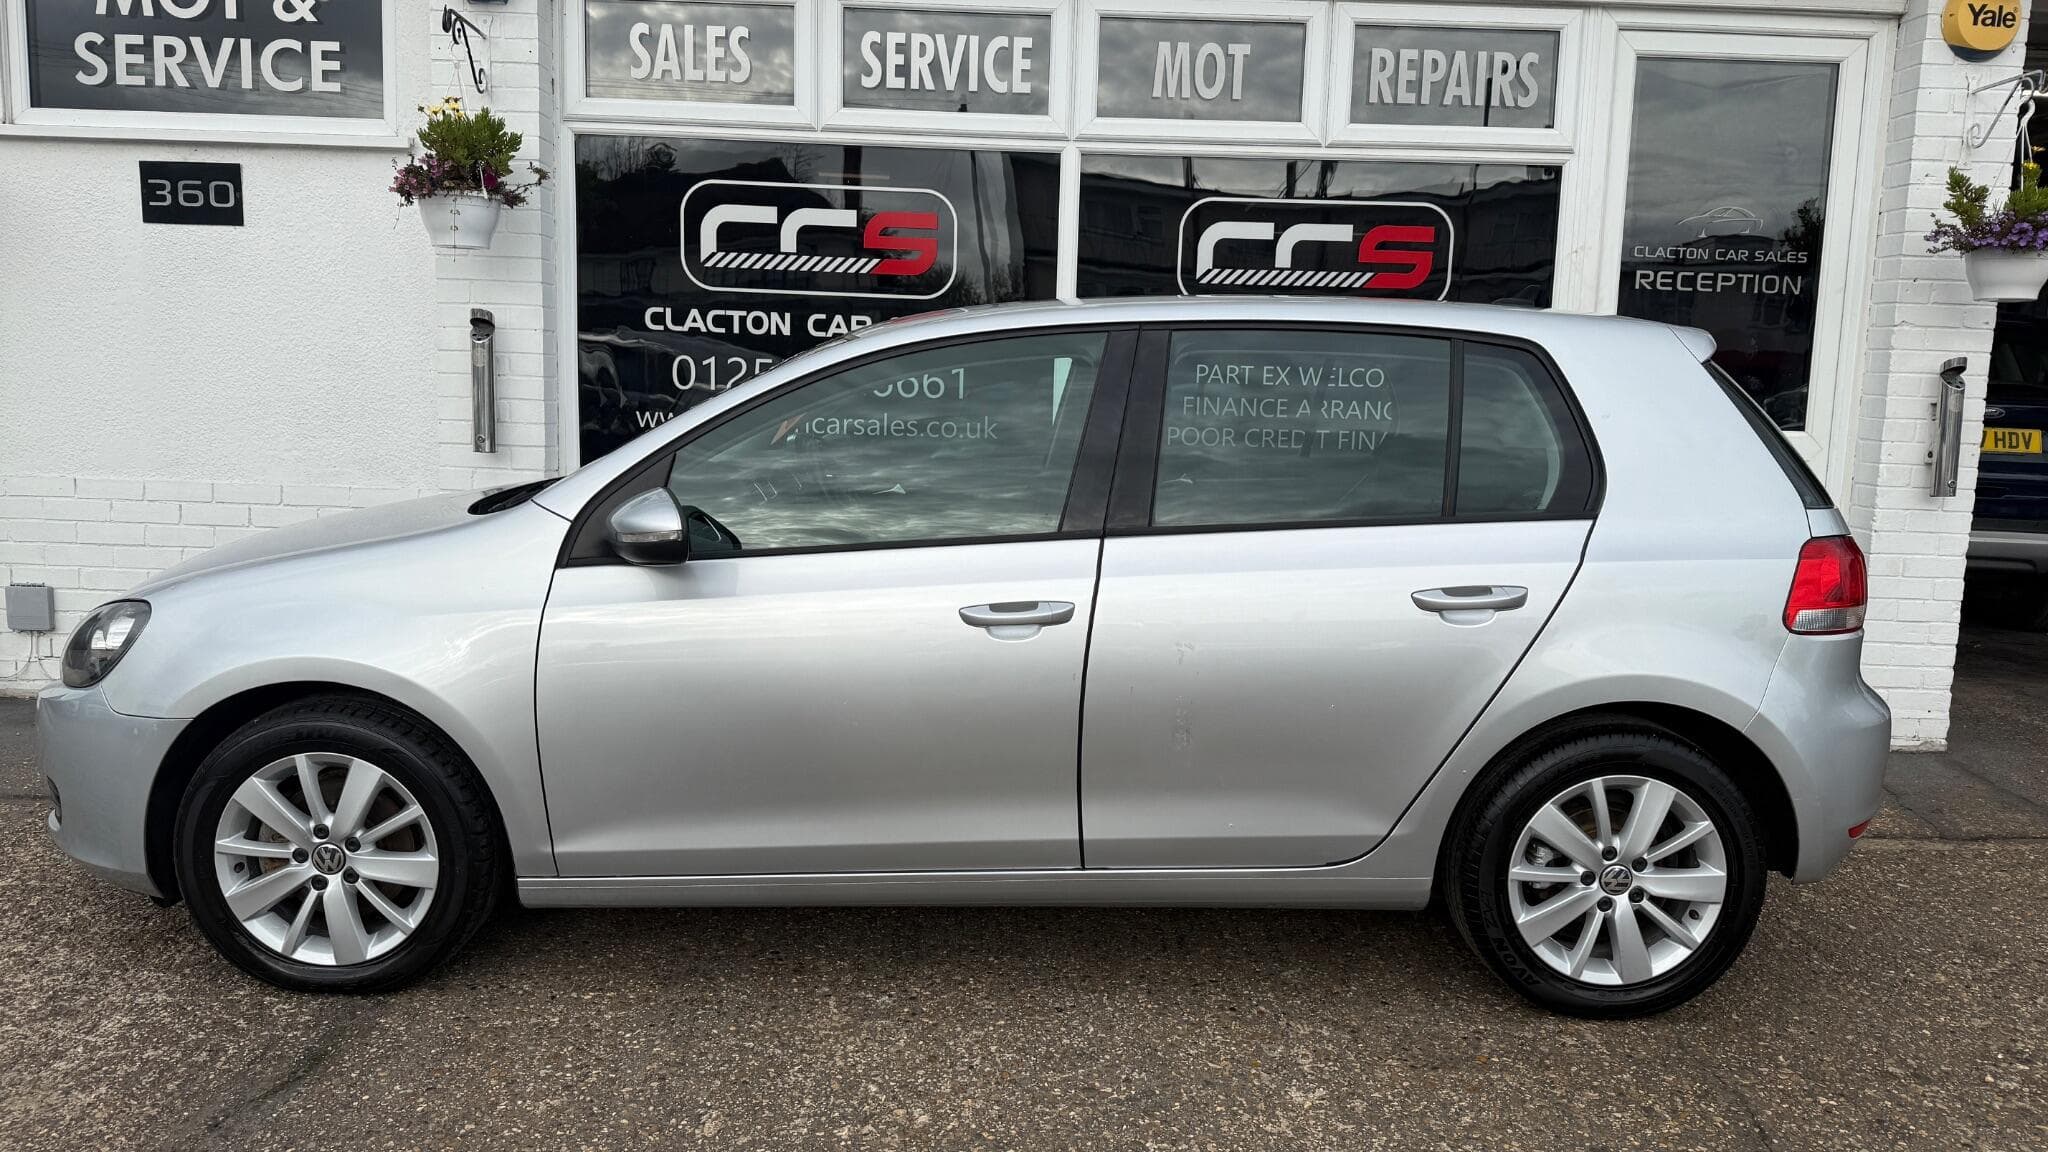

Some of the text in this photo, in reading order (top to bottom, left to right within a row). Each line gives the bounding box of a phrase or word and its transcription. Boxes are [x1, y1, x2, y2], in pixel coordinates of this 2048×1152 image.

[1968, 3, 2016, 28] Yale
[74, 32, 342, 92] SERVICE
[629, 22, 751, 84] SALES
[860, 30, 1033, 93] SERVICE
[1152, 41, 1251, 100] MOT
[1369, 47, 1540, 108] REPAIRS
[147, 179, 235, 208] 360
[1634, 246, 1808, 263] CLACTON CAR SALES
[1635, 270, 1802, 295] RECEPTION
[644, 307, 791, 336] CLACTON
[1196, 364, 1254, 385] PART
[1263, 366, 1291, 386] EX
[1183, 396, 1288, 418] FINANCE
[804, 413, 998, 440] carsales.co.uk
[1167, 427, 1236, 447] POOR
[1245, 429, 1330, 449] CREDT
[1994, 431, 2032, 450] HDV
